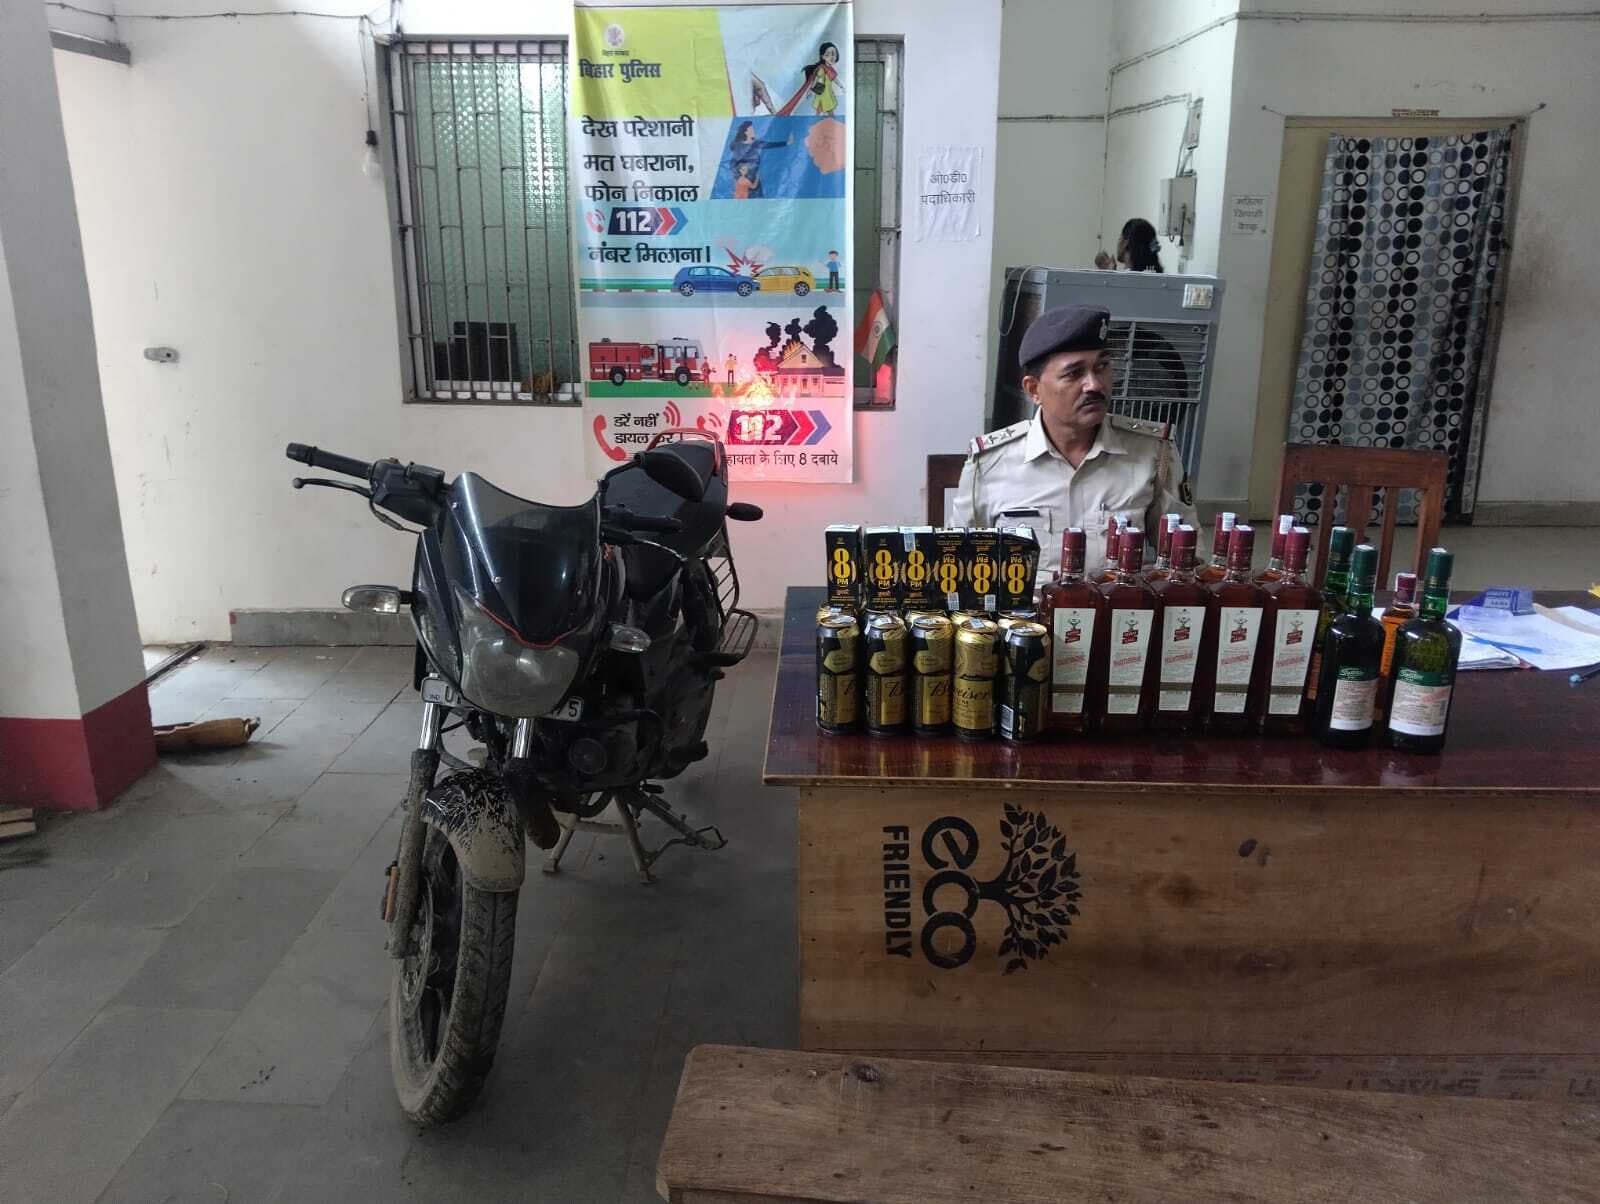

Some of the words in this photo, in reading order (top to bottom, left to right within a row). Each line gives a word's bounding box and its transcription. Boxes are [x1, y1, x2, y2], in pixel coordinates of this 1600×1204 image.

[579, 59, 614, 78] बिहार
[619, 59, 661, 83] पुलिस
[581, 115, 617, 137] देख
[624, 114, 694, 137] परेशानी
[583, 154, 615, 172] मत
[620, 154, 694, 174] घबराना,
[584, 181, 626, 202] फोन
[633, 180, 699, 202] निकाल
[920, 189, 976, 205] पदाधिकारी
[615, 210, 652, 232] 112
[588, 241, 632, 263] नंबर
[613, 412, 631, 427] डरें
[633, 412, 660, 428] नहीं
[735, 414, 783, 441] 112
[614, 433, 650, 444] डायल
[724, 453, 756, 467] हायता
[759, 450, 770, 465] के
[774, 450, 796, 467] लिए
[799, 453, 807, 466] 8
[833, 547, 850, 579] 8
[875, 549, 892, 581] 8
[907, 550, 925, 581] 8
[940, 563, 958, 593] 8
[973, 563, 991, 594] 8
[1007, 563, 1025, 594] 8
[883, 825, 912, 958] FRIENDLY
[920, 816, 979, 970] eco
